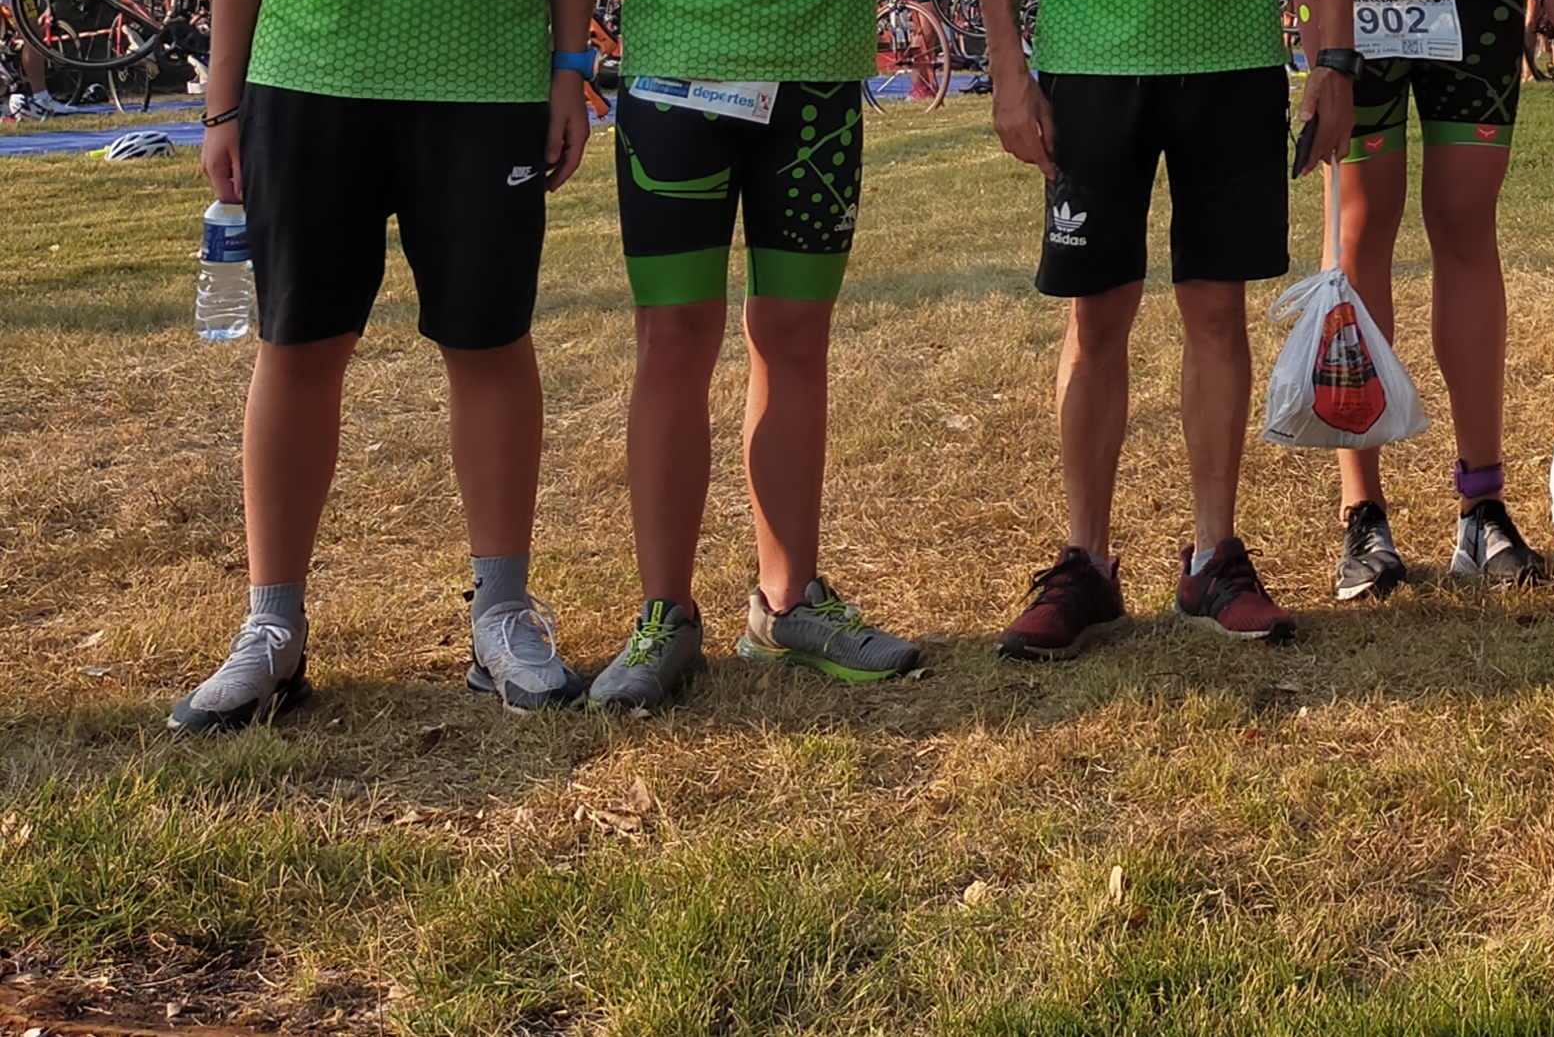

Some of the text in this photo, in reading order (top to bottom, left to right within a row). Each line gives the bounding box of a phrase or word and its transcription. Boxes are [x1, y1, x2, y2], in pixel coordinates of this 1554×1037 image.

[1357, 6, 1429, 34] 902
[692, 86, 755, 109] deportes
[1050, 232, 1087, 246] adidas
